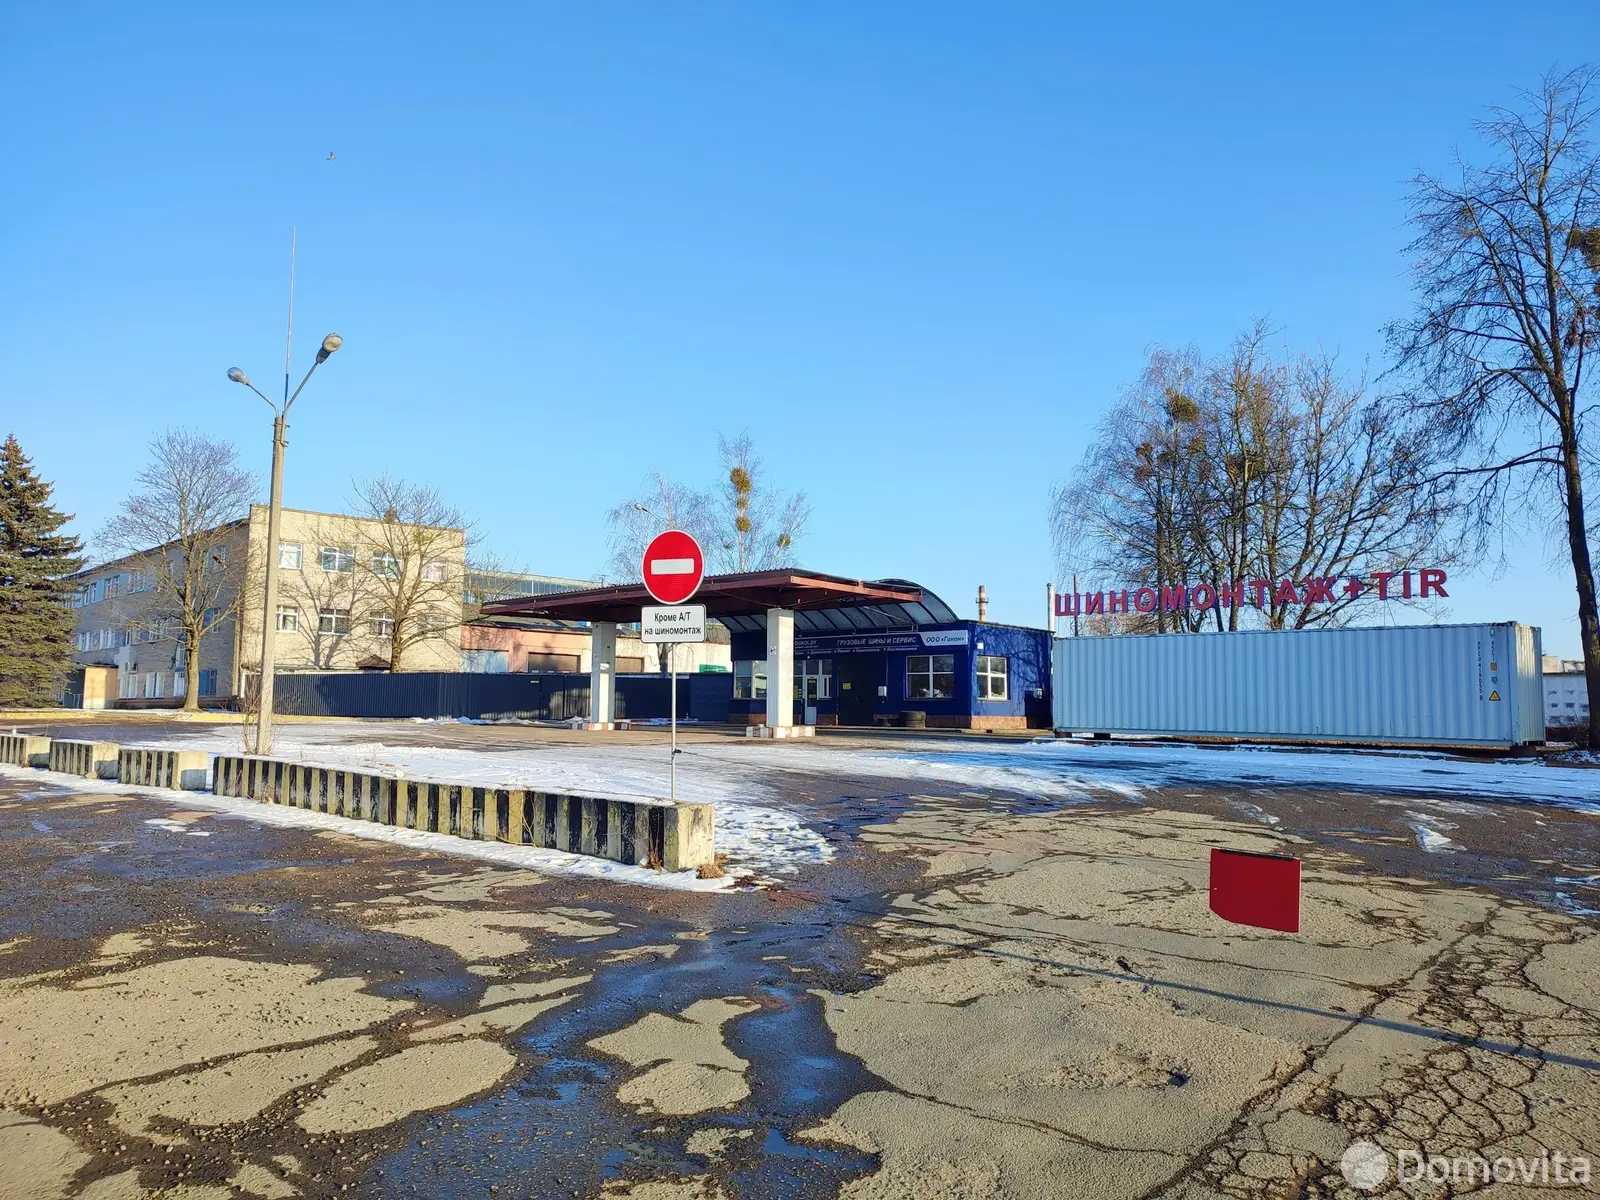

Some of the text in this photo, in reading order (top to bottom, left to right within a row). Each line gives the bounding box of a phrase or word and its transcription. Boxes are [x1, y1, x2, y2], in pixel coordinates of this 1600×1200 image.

[654, 612, 677, 623] Кроме
[654, 627, 702, 635] шиномонтаж
[836, 638, 866, 646] ГРУЗОВЫЕ
[868, 637, 886, 645] ШИНЫ
[892, 636, 917, 644] СЕРВИС
